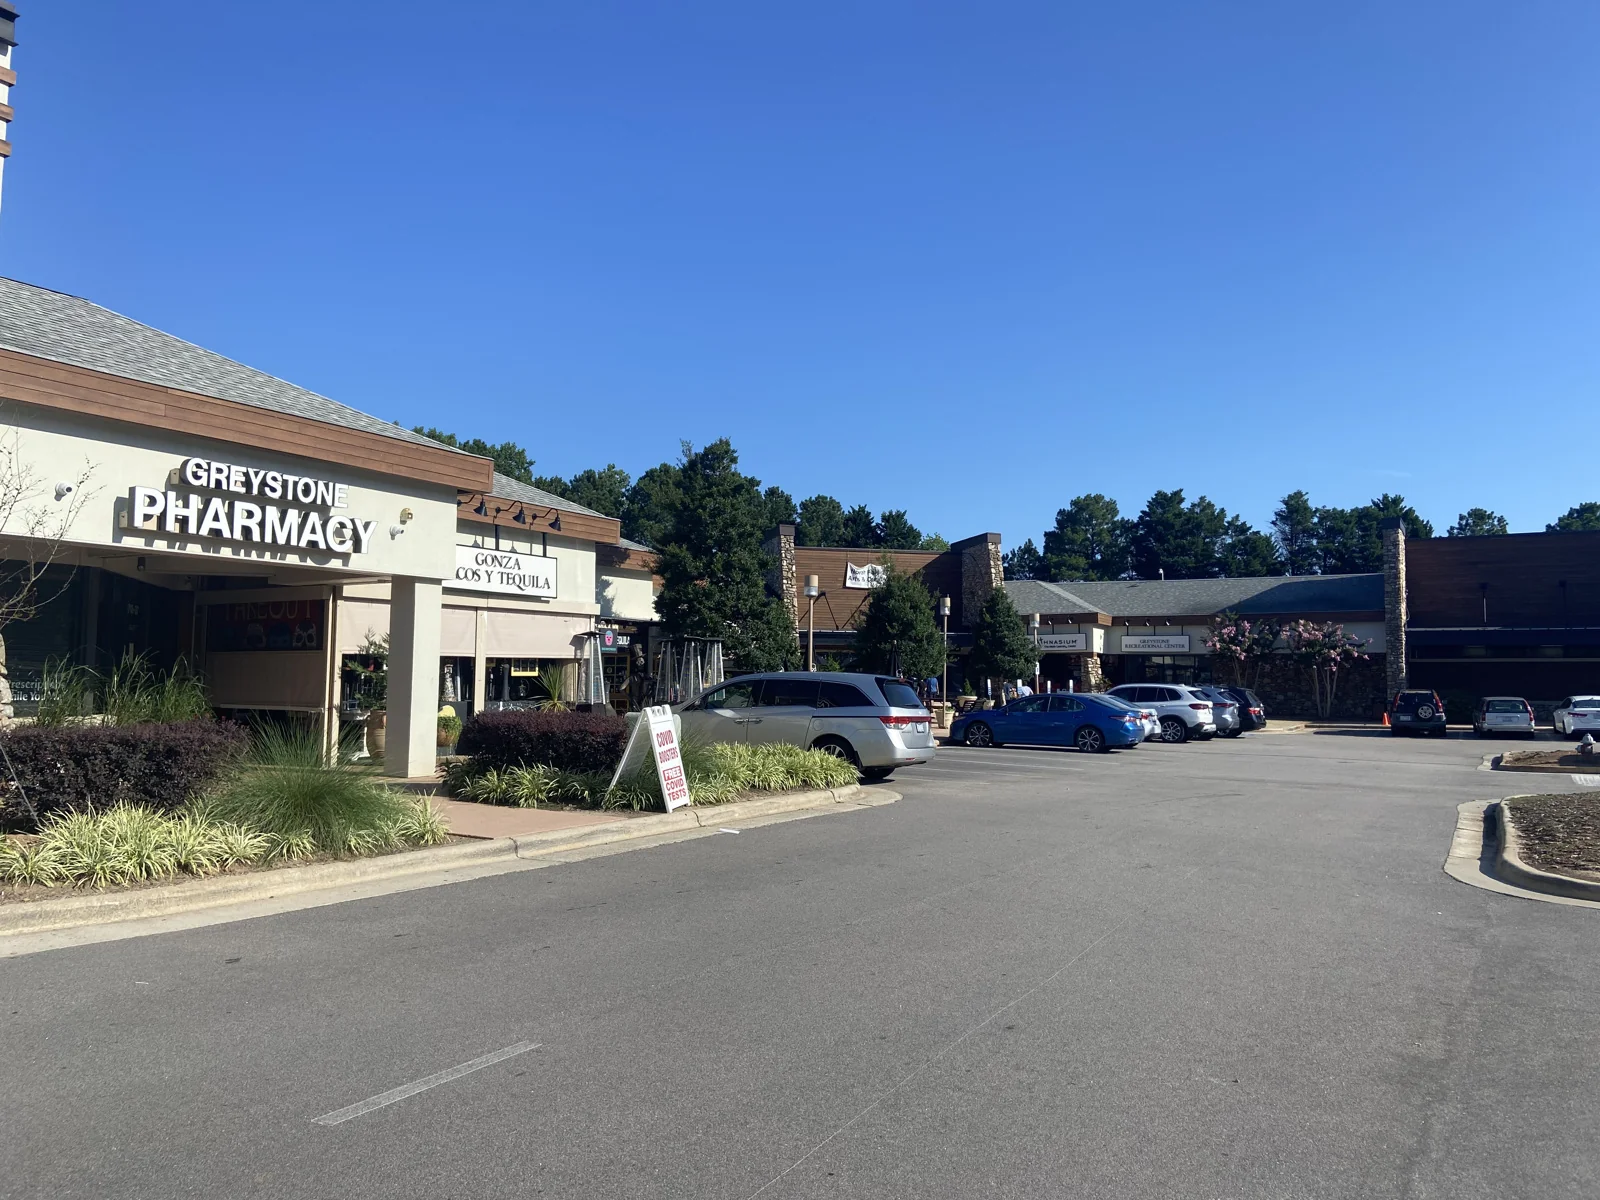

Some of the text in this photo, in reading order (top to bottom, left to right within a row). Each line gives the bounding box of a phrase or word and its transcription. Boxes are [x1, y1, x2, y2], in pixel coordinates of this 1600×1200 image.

[185, 457, 350, 509] GREYSTONE
[130, 486, 379, 554] PHARMACY
[475, 552, 521, 570] GONZA
[456, 566, 551, 591] COS Y TEQUILA
[656, 730, 673, 747] COVID
[659, 747, 678, 763] BOOSTERS
[665, 769, 681, 779] FREE
[666, 779, 684, 791] COVID
[668, 788, 687, 801] TESTS
